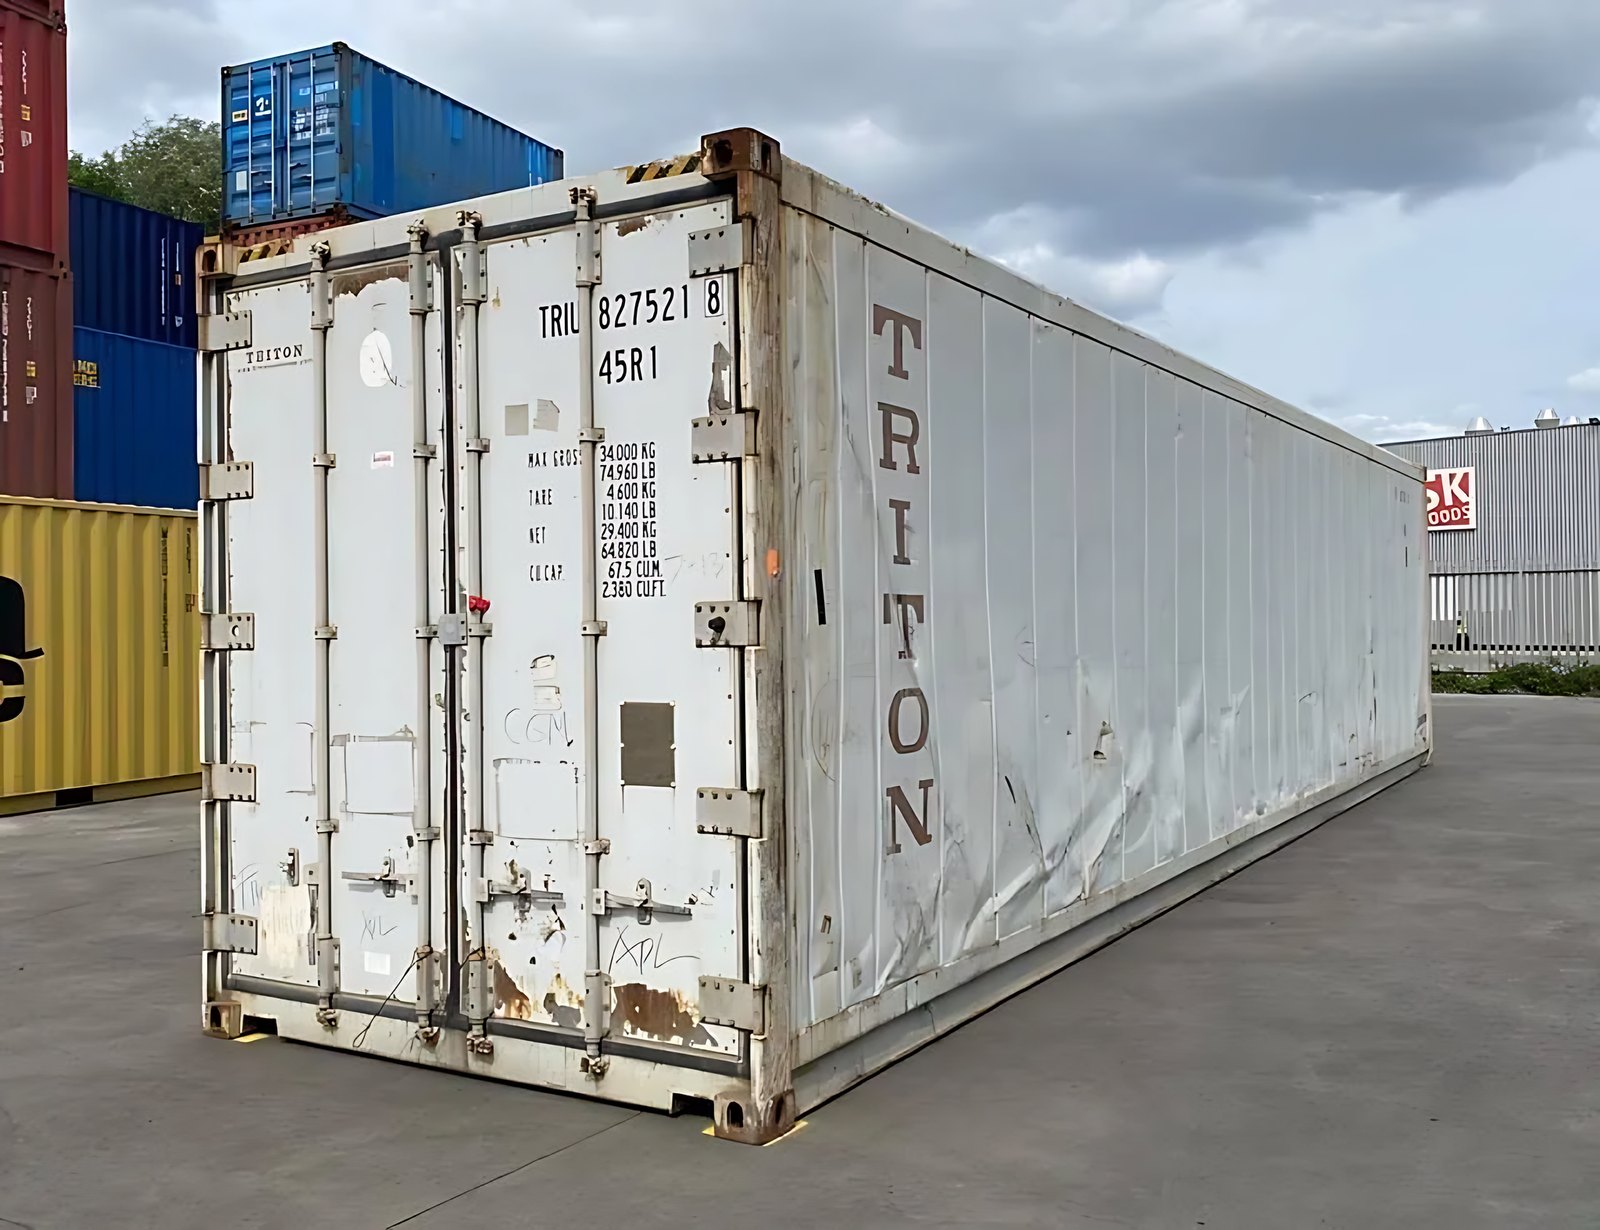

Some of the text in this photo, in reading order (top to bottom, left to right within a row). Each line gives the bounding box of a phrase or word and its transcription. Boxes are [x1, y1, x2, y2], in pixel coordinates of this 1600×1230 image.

[538, 279, 721, 338] TRIU 827521 8
[598, 345, 657, 385] 45R1
[641, 441, 656, 460] KG
[641, 461, 656, 479] LB
[529, 488, 553, 506] TARE
[641, 481, 656, 499] KG
[642, 500, 656, 519] LB
[529, 526, 546, 544] NET
[642, 520, 657, 538] KG
[642, 540, 657, 558] LB
[873, 303, 934, 856] TRITON
